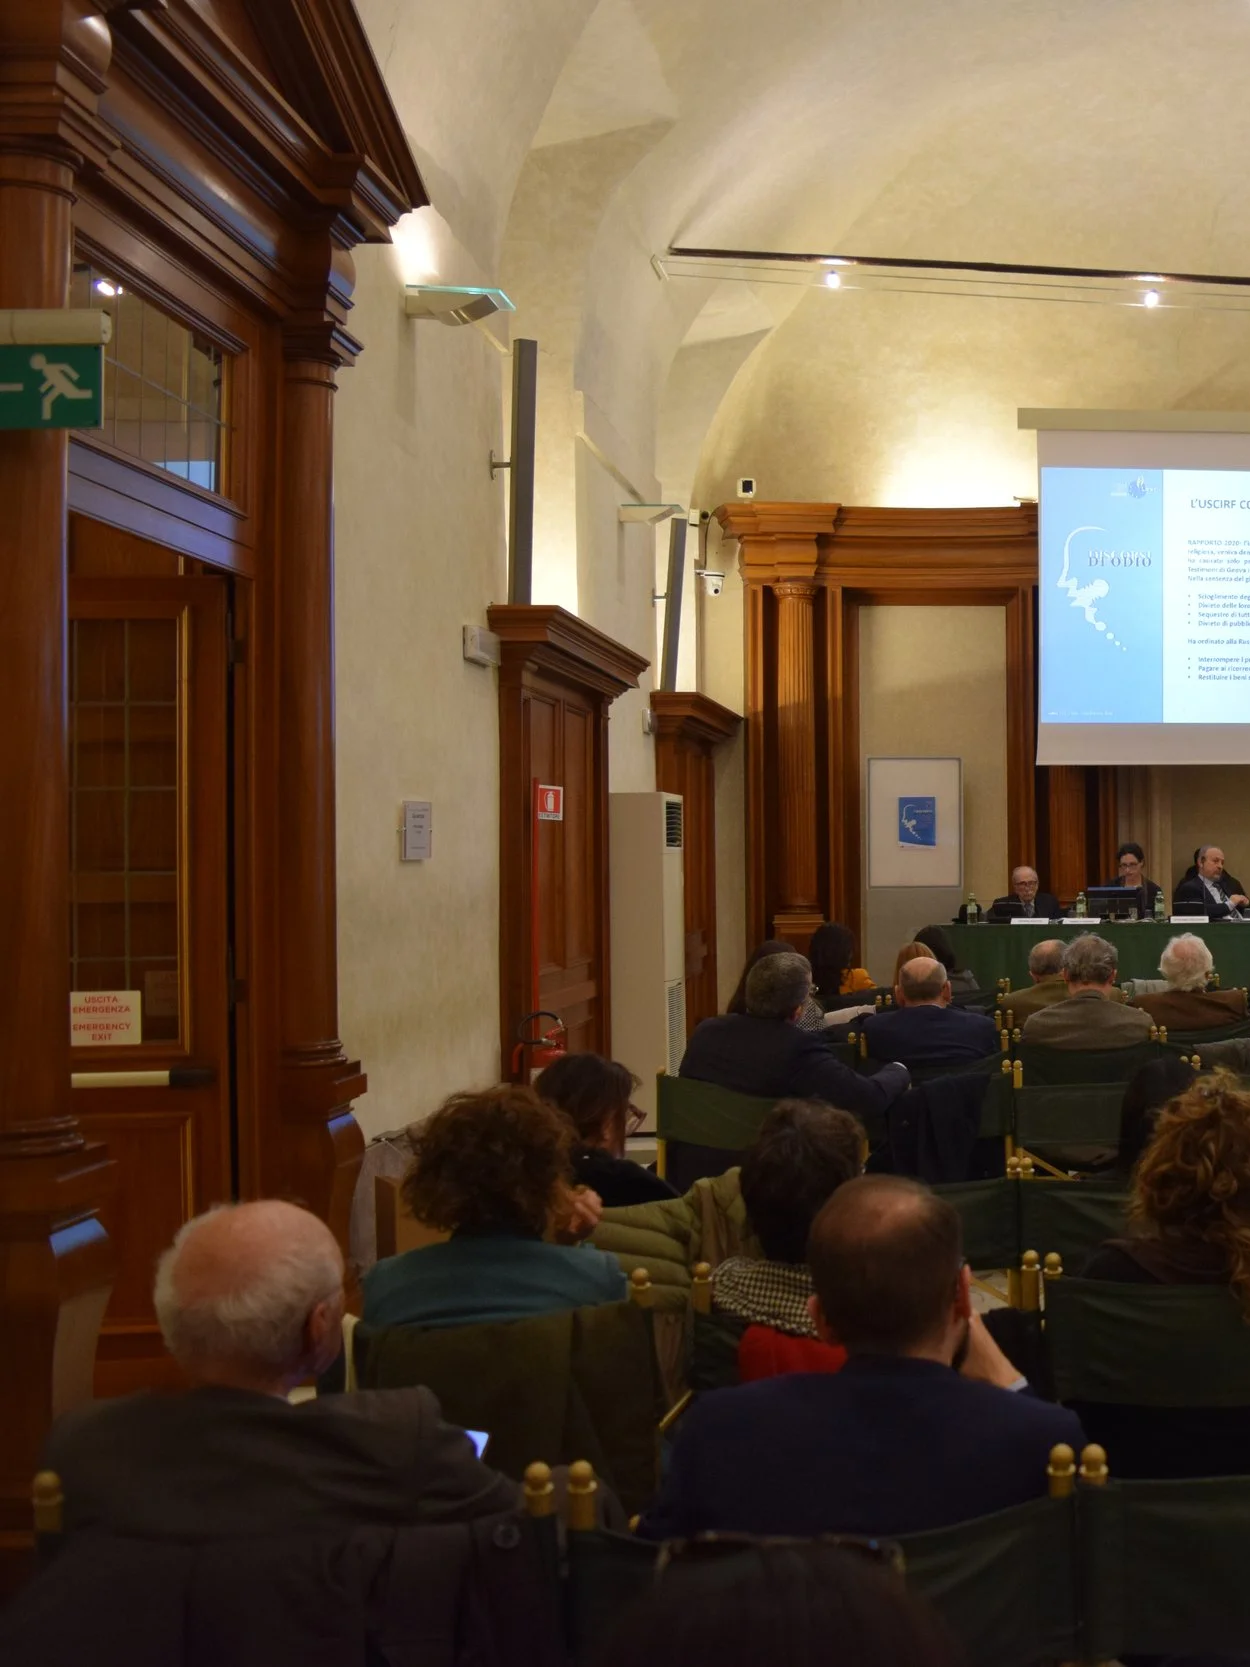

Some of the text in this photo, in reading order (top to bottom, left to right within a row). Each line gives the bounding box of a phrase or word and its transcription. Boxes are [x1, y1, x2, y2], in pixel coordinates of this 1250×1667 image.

[1191, 499, 1236, 509] L'USCIRF
[1088, 557, 1152, 567] DI ODIO
[1198, 593, 1238, 601] Scioglimento
[1198, 611, 1229, 619] Sequestro
[1198, 656, 1239, 664] Interrompere
[1198, 665, 1219, 673] Pagare
[85, 995, 119, 1004] USCITA
[73, 1005, 131, 1014] EMERGENZA
[73, 1022, 132, 1032] EMERGENCY
[91, 1033, 112, 1042] EXIT
